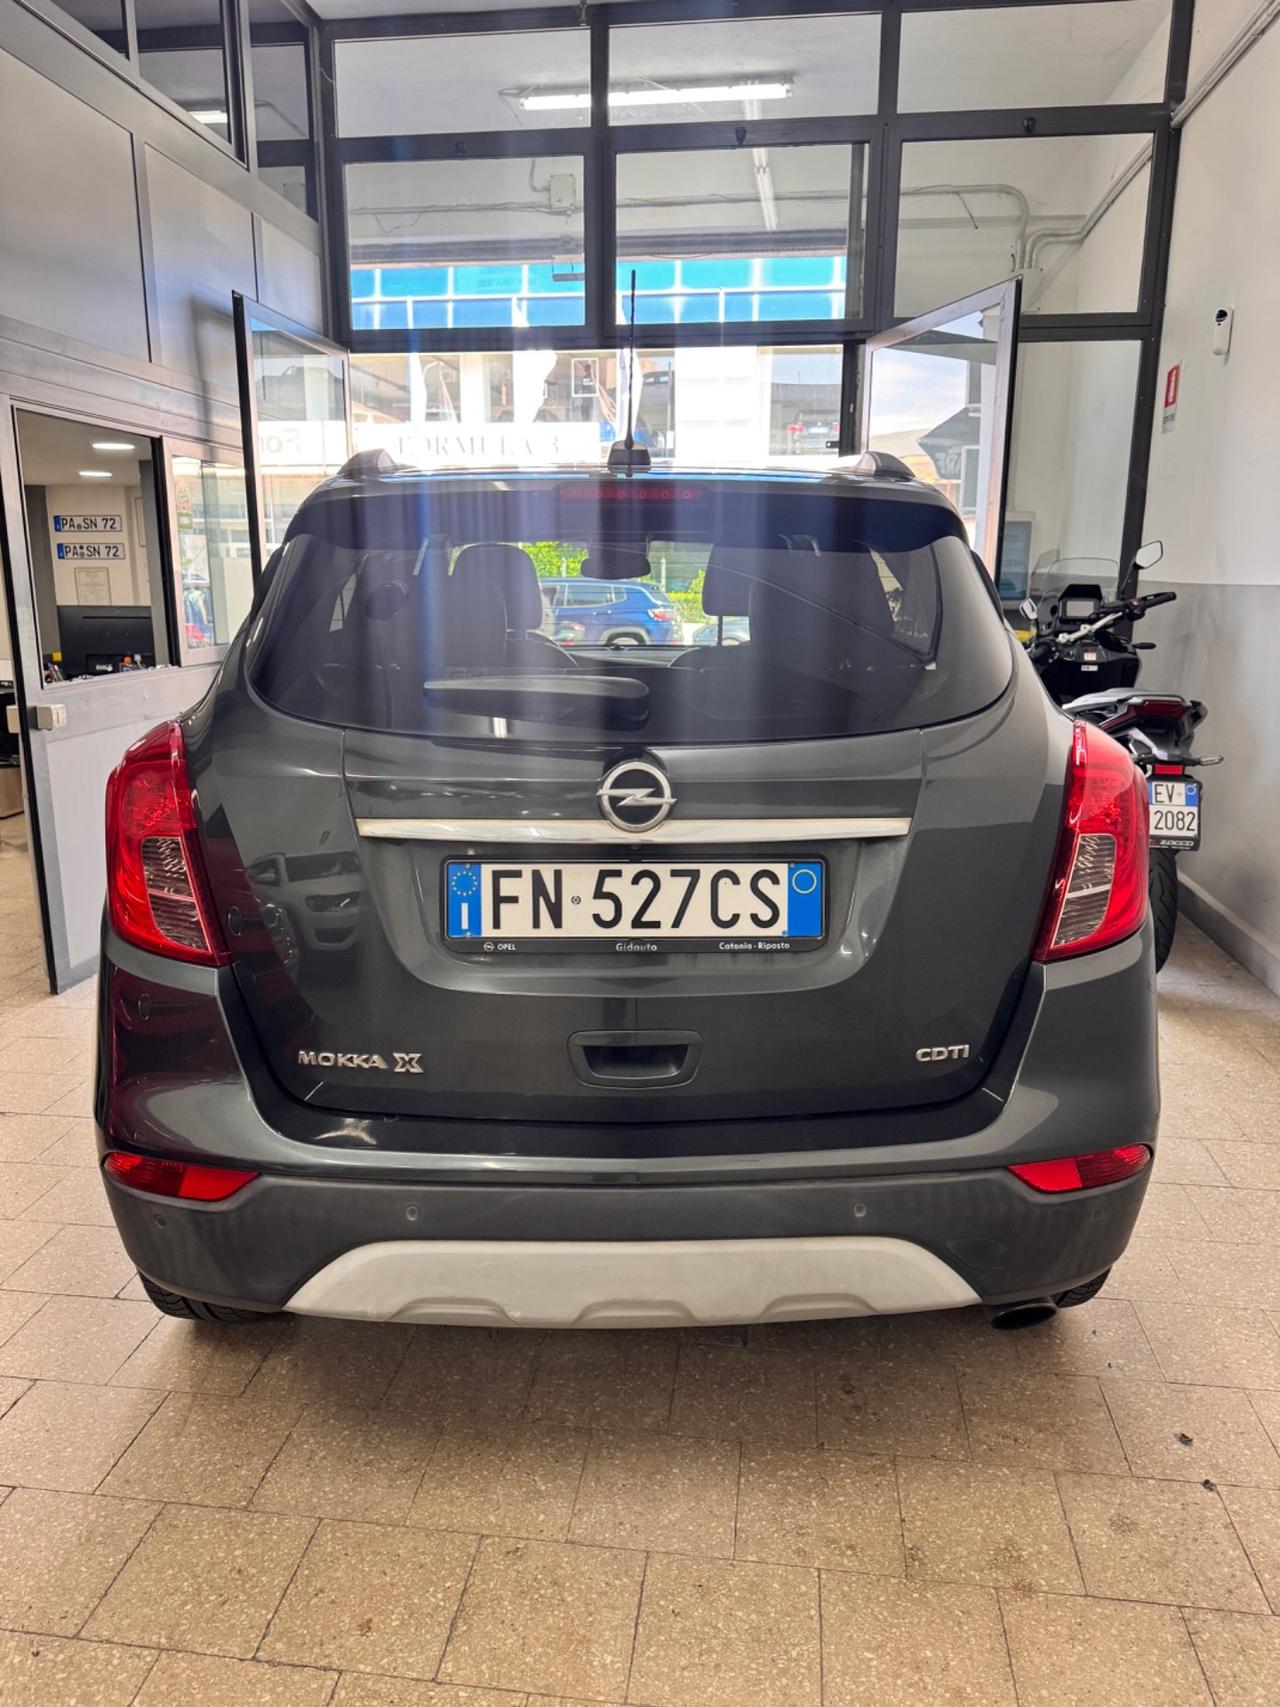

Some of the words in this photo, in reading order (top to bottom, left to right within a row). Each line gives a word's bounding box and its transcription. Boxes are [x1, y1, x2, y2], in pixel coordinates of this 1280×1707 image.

[61, 517, 76, 530] PA
[82, 517, 98, 530] SN
[102, 517, 117, 530] 72
[64, 545, 79, 557] PA
[86, 545, 101, 557] SN
[105, 545, 120, 557] 72
[1154, 783, 1175, 803] EV
[1153, 810, 1196, 831] 2082
[491, 869, 563, 930] FN
[591, 869, 781, 930] 527CS
[497, 943, 517, 951] OPEL
[615, 942, 658, 952] Gidauto
[758, 941, 790, 951] Riposto
[915, 1044, 970, 1062] CDTI
[298, 1050, 388, 1069] MOKKA
[392, 1052, 424, 1073] X
